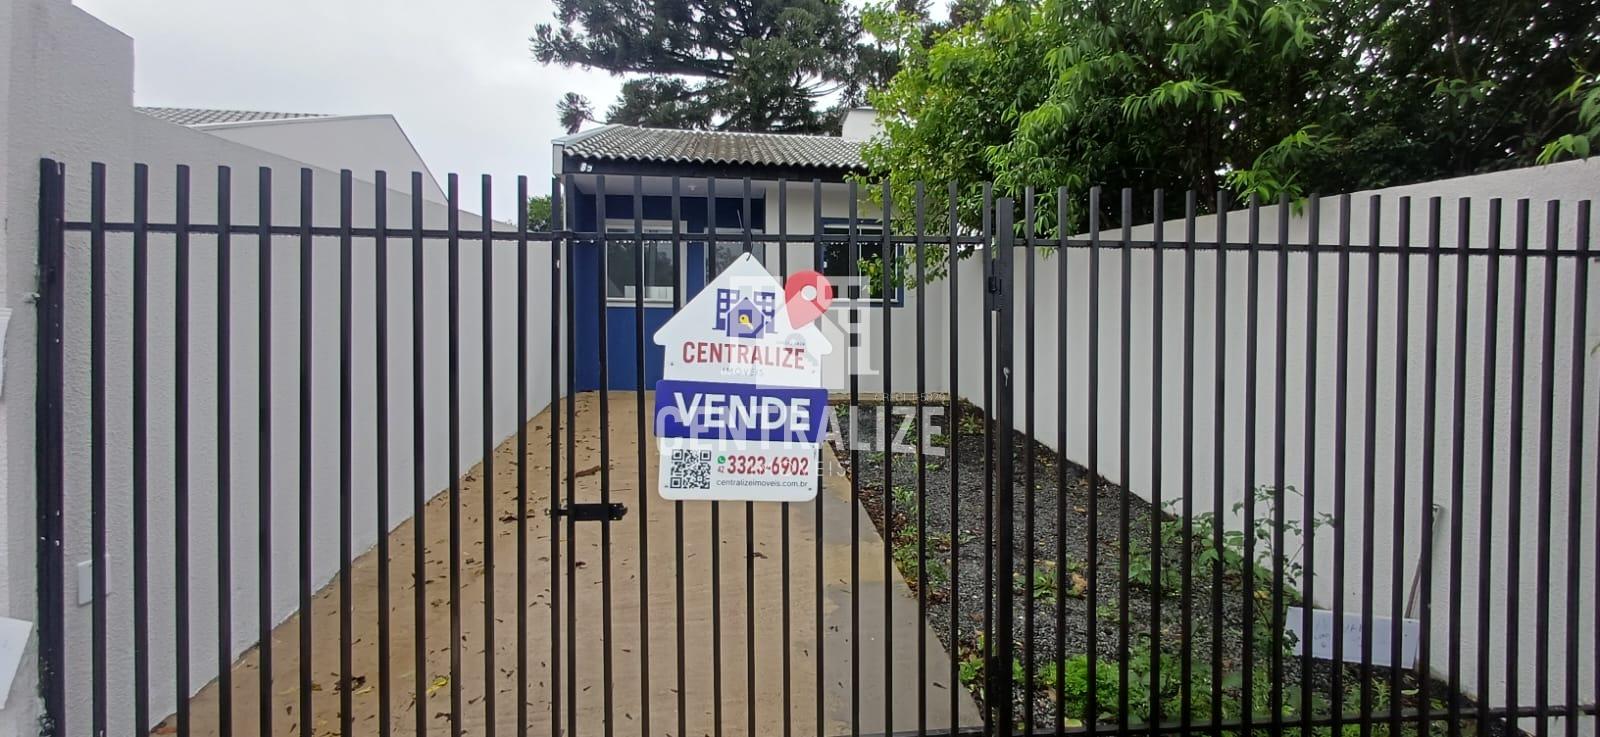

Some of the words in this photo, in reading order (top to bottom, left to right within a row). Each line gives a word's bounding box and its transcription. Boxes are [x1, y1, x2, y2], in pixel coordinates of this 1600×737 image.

[682, 341, 806, 371] CENTRALIZE
[673, 392, 811, 431] VENDE
[727, 455, 809, 476] 3323-6902
[716, 479, 808, 487] centralizeimoveis.com.br
